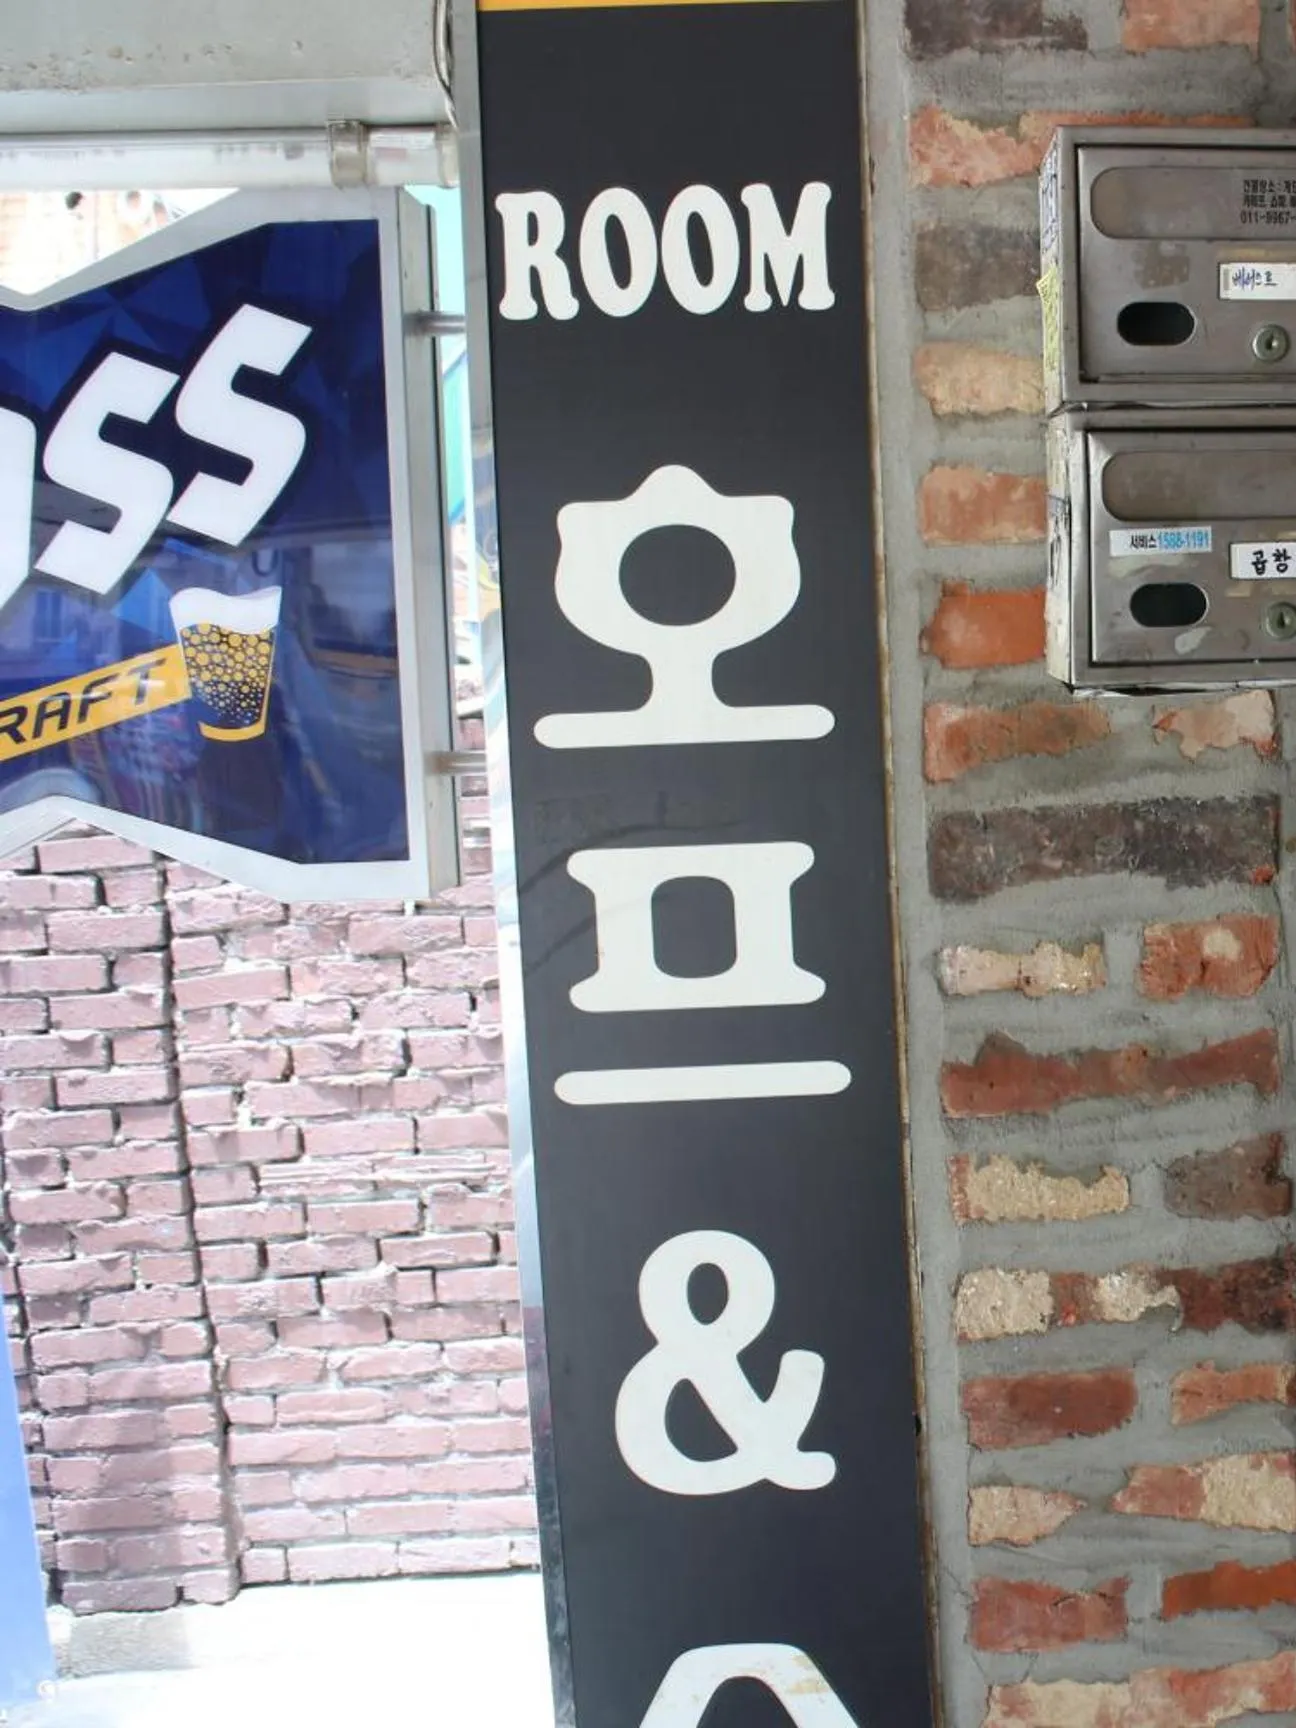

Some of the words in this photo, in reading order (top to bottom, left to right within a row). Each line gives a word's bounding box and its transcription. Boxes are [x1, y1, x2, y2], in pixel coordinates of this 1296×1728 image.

[495, 182, 835, 320] ROOM
[1250, 548, 1292, 577] 곱창
[614, 1230, 838, 1496] &
